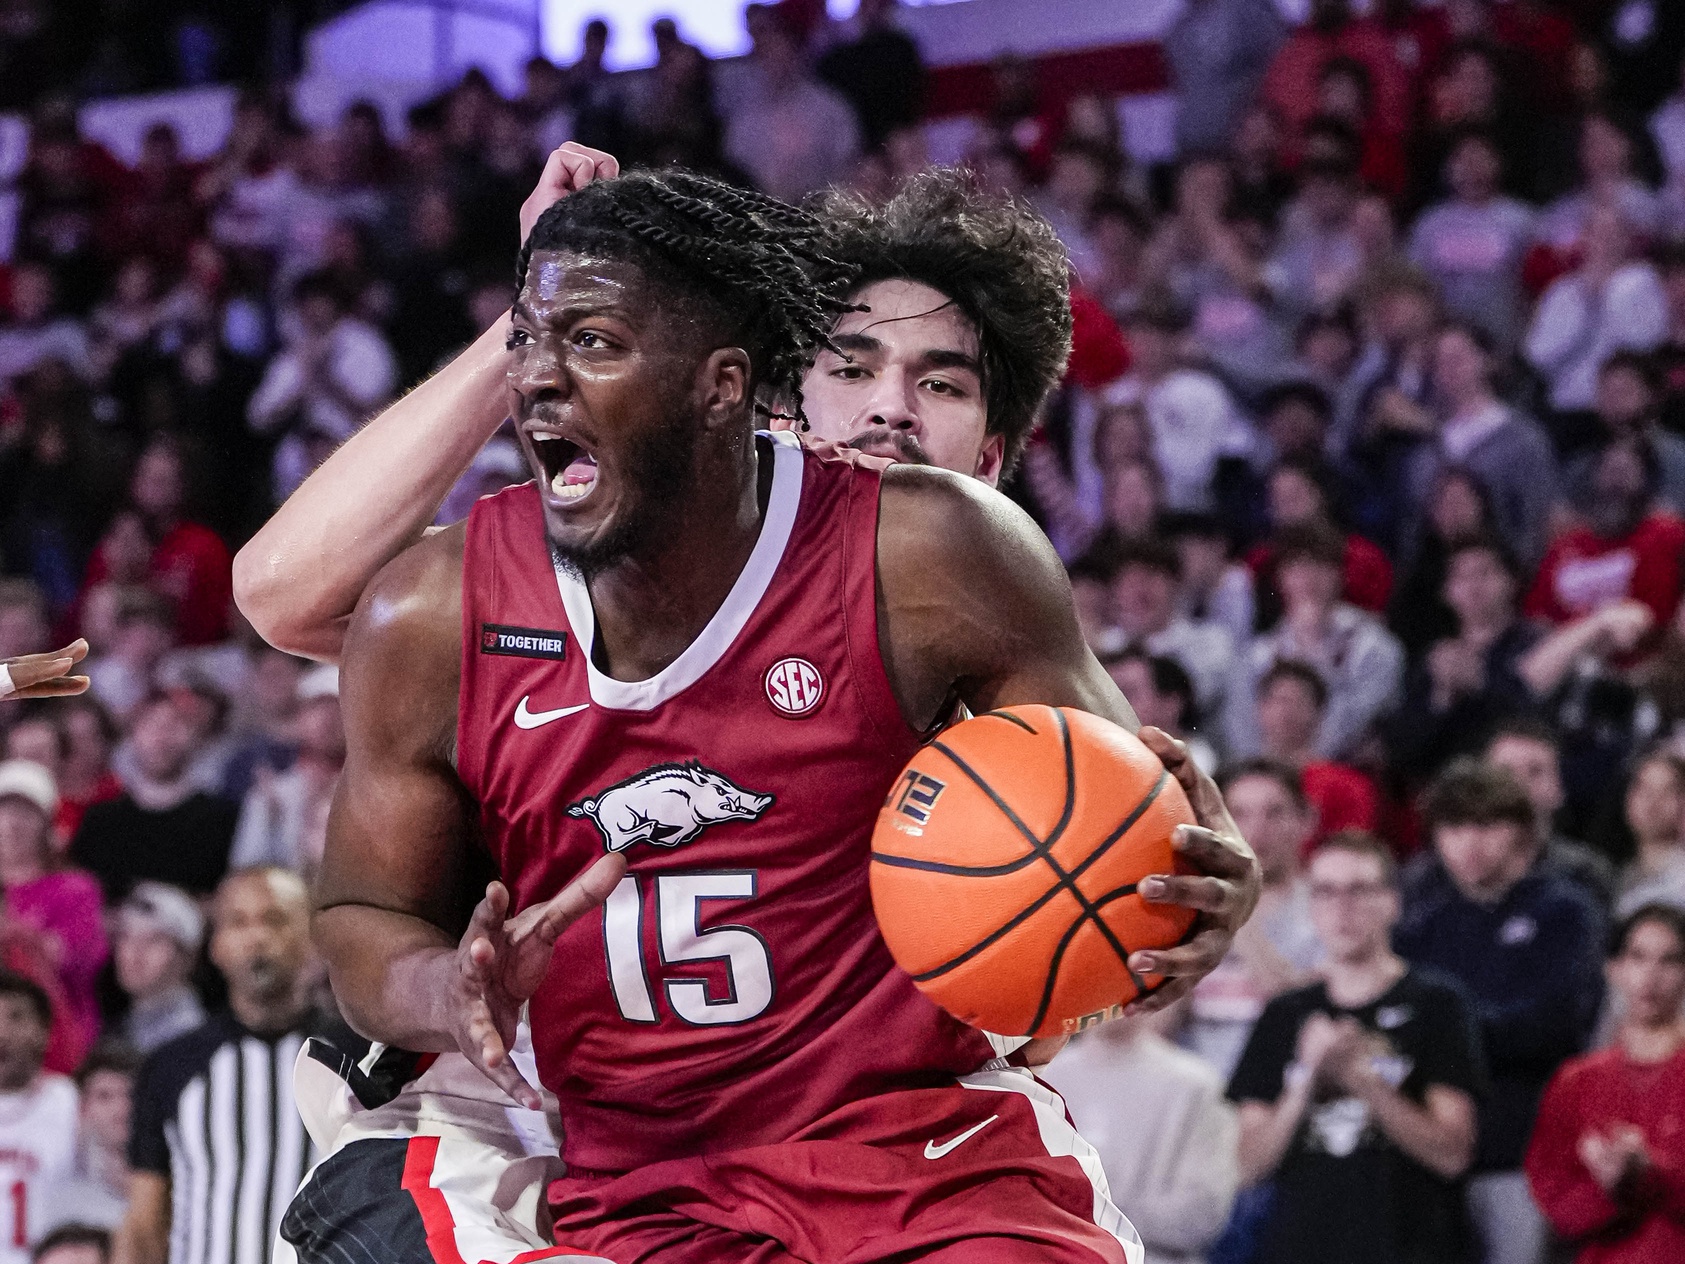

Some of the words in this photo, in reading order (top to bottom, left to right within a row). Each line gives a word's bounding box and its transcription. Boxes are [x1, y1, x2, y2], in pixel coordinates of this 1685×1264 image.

[498, 634, 563, 653] TOGETHER
[769, 661, 819, 711] SEC
[602, 869, 778, 1027] 15
